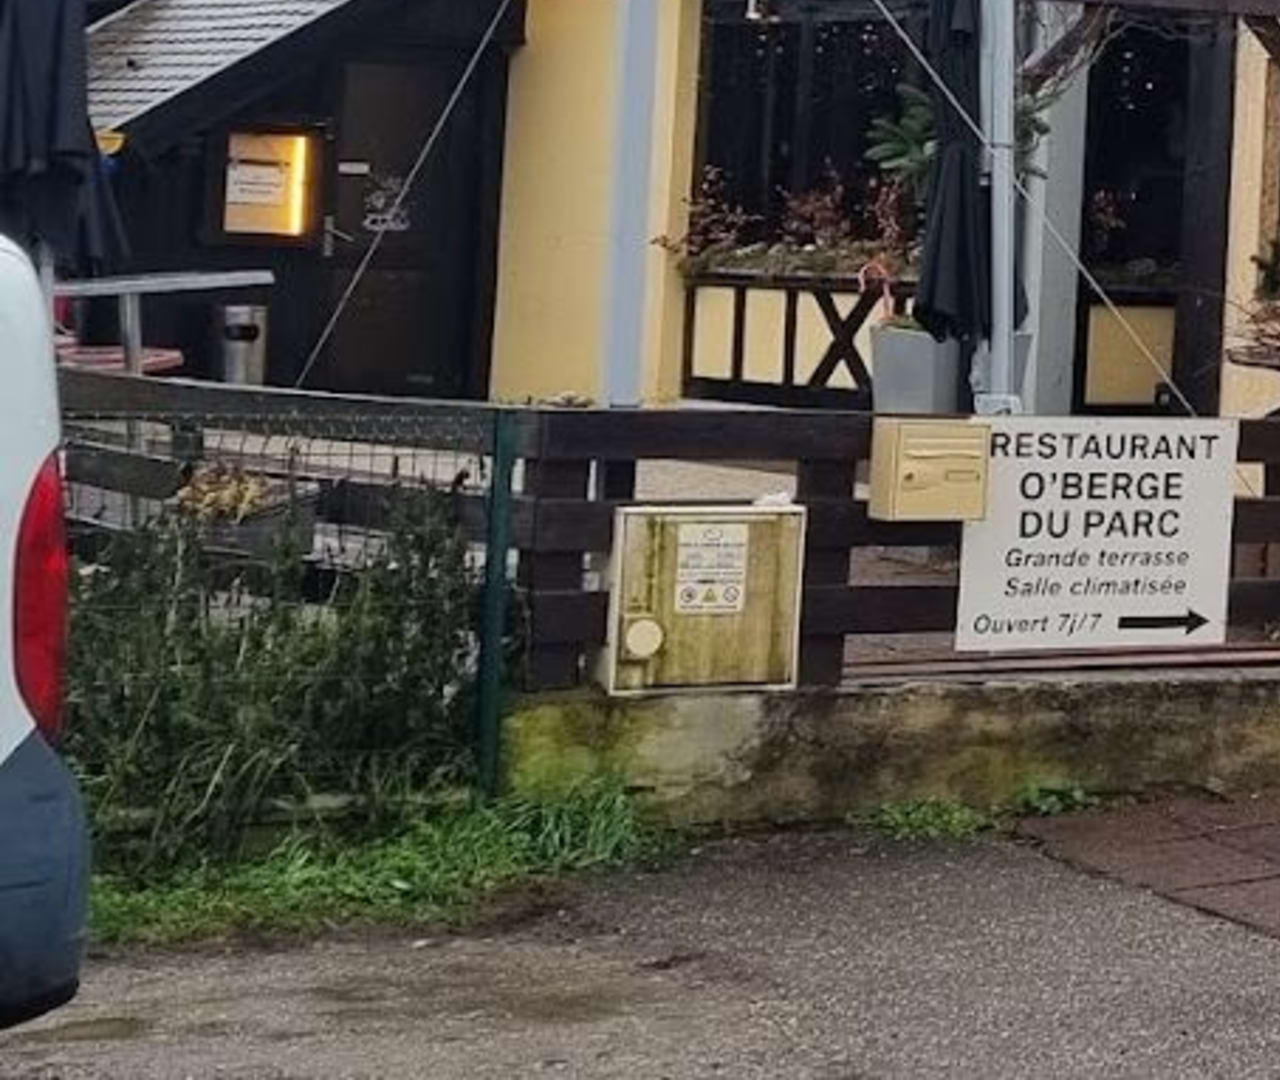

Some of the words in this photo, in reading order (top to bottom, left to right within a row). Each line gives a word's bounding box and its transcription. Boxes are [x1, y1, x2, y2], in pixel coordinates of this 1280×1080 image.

[990, 431, 1220, 460] RESTAURANT
[1019, 471, 1184, 501] O'BERGE
[1019, 510, 1071, 539] DU
[1083, 509, 1181, 539] PARC
[1005, 548, 1091, 568] Grande
[1098, 547, 1190, 567] terrasse
[1003, 576, 1062, 598] Salle
[1069, 574, 1187, 597] climatisée
[972, 614, 1049, 635] Ouvert
[1058, 612, 1103, 639] 7j/7
